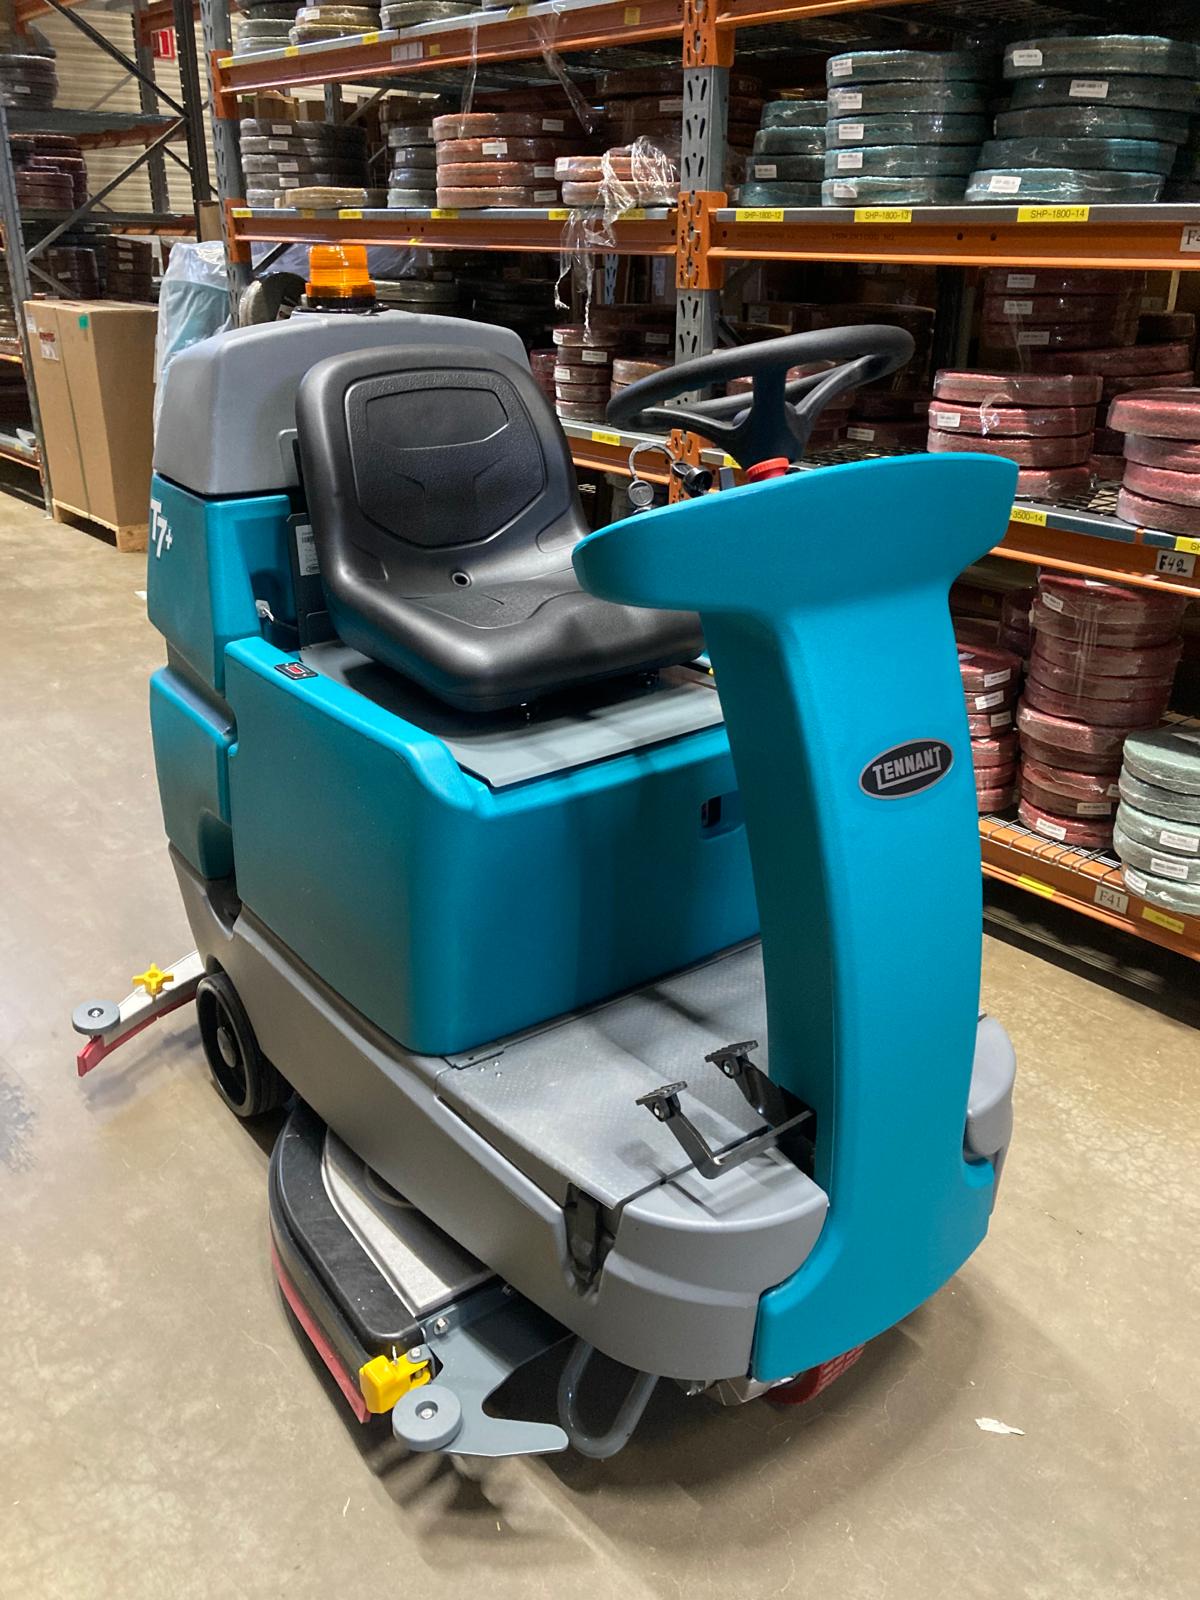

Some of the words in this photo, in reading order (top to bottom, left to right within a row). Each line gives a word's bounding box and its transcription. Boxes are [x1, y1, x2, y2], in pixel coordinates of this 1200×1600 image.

[743, 210, 782, 220] SHP-1800-12
[864, 210, 910, 220] SHP-1800-13
[1031, 208, 1085, 219] SHP-1800-14
[149, 498, 173, 559] T7+
[1158, 554, 1188, 574] F42
[872, 746, 942, 790] TENNANT
[1099, 889, 1122, 908] F41
